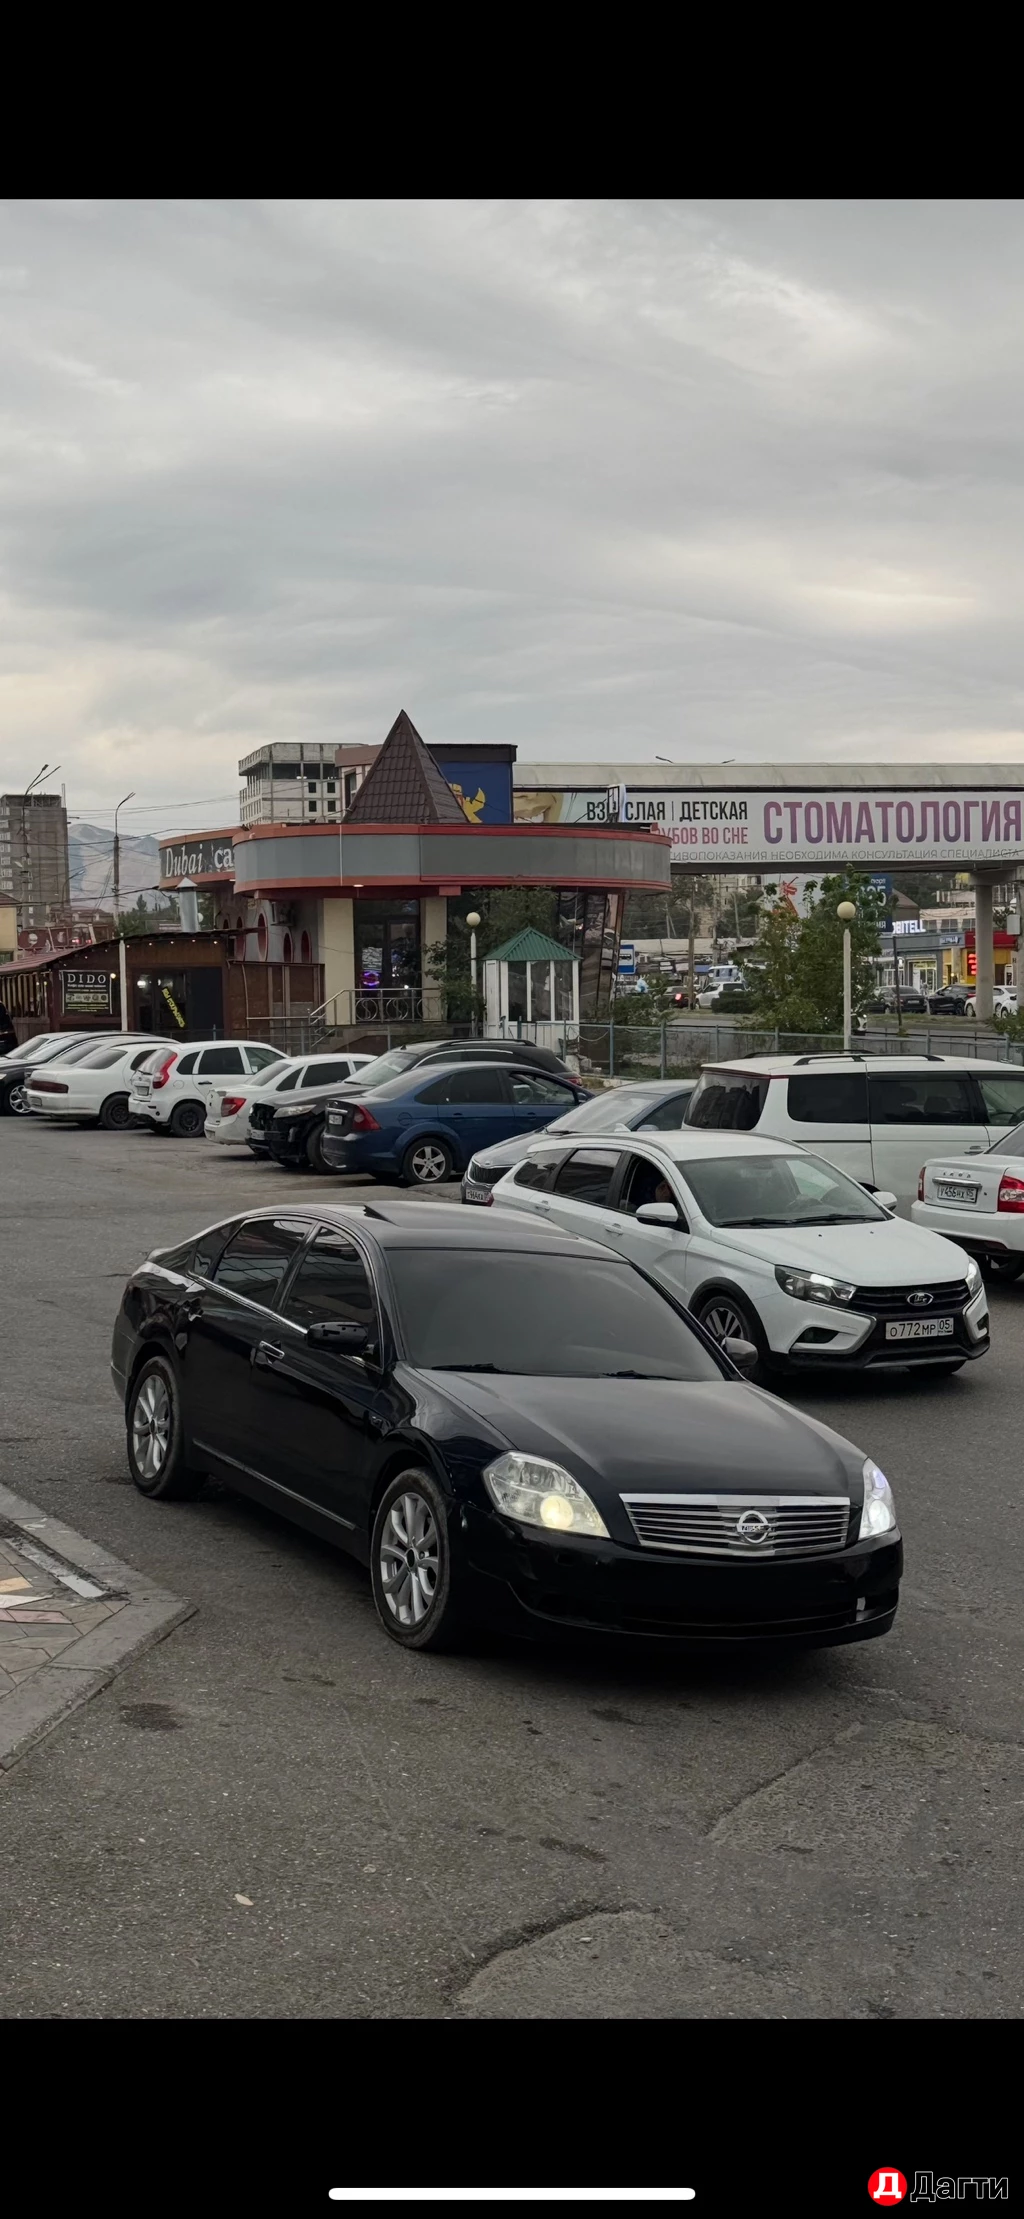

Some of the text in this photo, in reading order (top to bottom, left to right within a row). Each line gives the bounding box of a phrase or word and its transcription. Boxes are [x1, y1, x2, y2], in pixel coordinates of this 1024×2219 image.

[587, 801, 748, 822] ВЗСЛАЯ ДЕТСКАЯ
[763, 800, 1022, 844] СТОМАТОЛОГИЯ
[656, 827, 749, 844] УБОВ ВО СНЕ
[165, 843, 235, 877] Dubai ca
[670, 848, 1020, 861] ИВОПОКАЗАНИЯ НЕОБХОДИМА КОНСУЛЬТАЦИЯ СПЕЦИАЛИСТА
[67, 973, 106, 984] DIDO
[939, 1319, 951, 1330] 05
